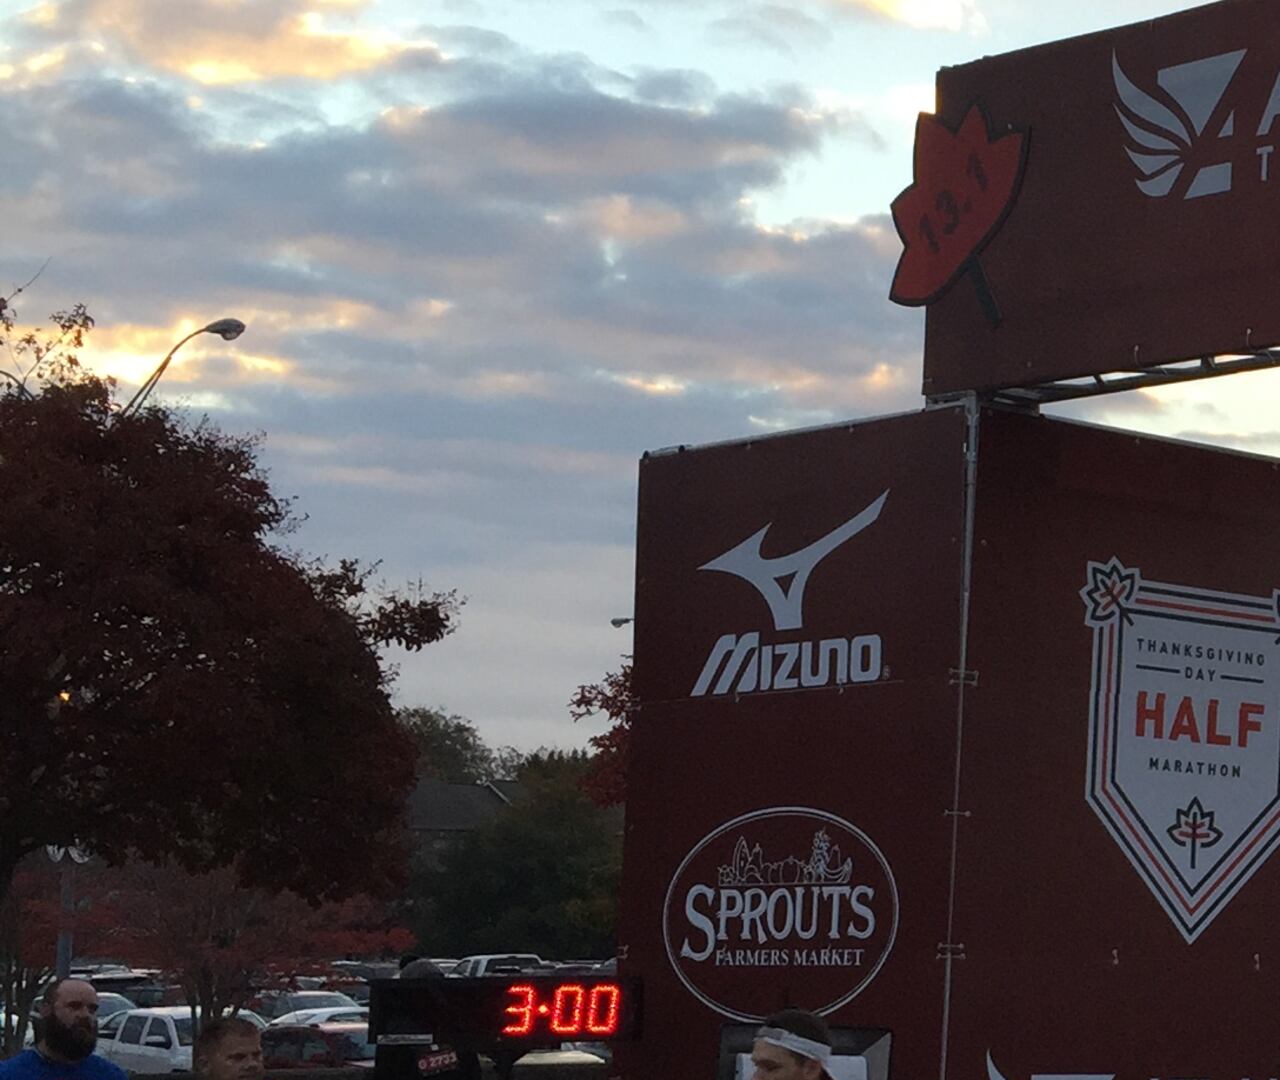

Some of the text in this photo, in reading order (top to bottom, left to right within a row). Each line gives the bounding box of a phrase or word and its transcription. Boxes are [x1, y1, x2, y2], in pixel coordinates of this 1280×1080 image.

[1137, 638, 1266, 666] THANKSGIVING
[1185, 667, 1216, 682] DAY
[1136, 691, 1265, 748] HALF
[1149, 757, 1241, 778] MARATHON
[680, 884, 876, 962] SPROUTS
[715, 949, 865, 967] FARMERS MARKET
